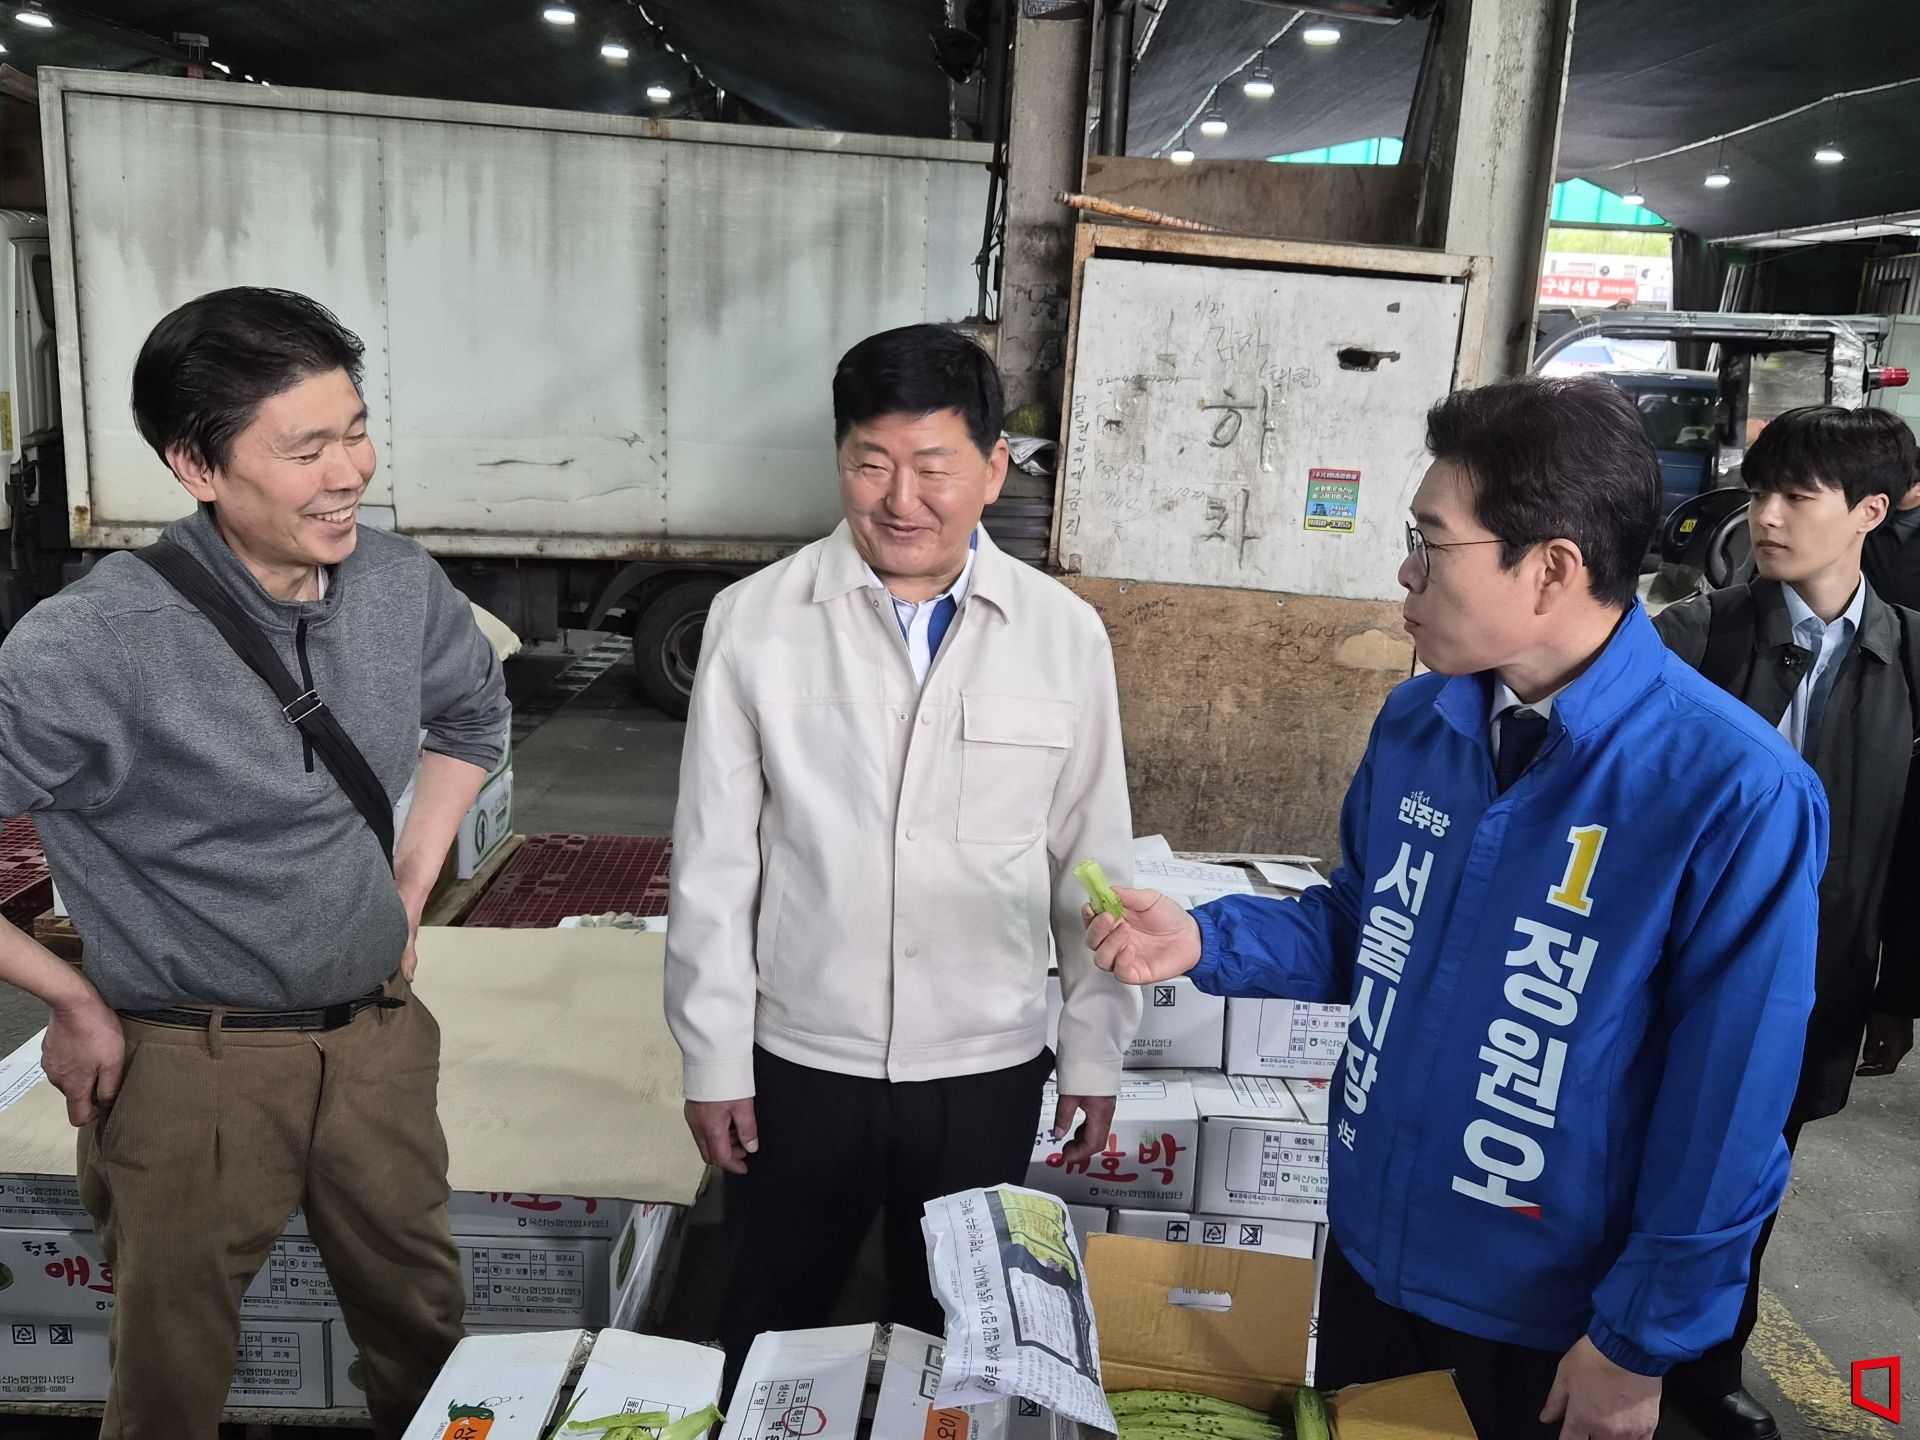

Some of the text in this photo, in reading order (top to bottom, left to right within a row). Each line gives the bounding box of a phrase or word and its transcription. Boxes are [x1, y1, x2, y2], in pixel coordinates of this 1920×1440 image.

[1542, 278, 1601, 298] 구내식당
[1398, 796, 1451, 837] 민주당
[1343, 841, 1434, 1115] 서울시장
[1451, 823, 1608, 1218] 1 정원오
[982, 1365, 1002, 1387] 하루
